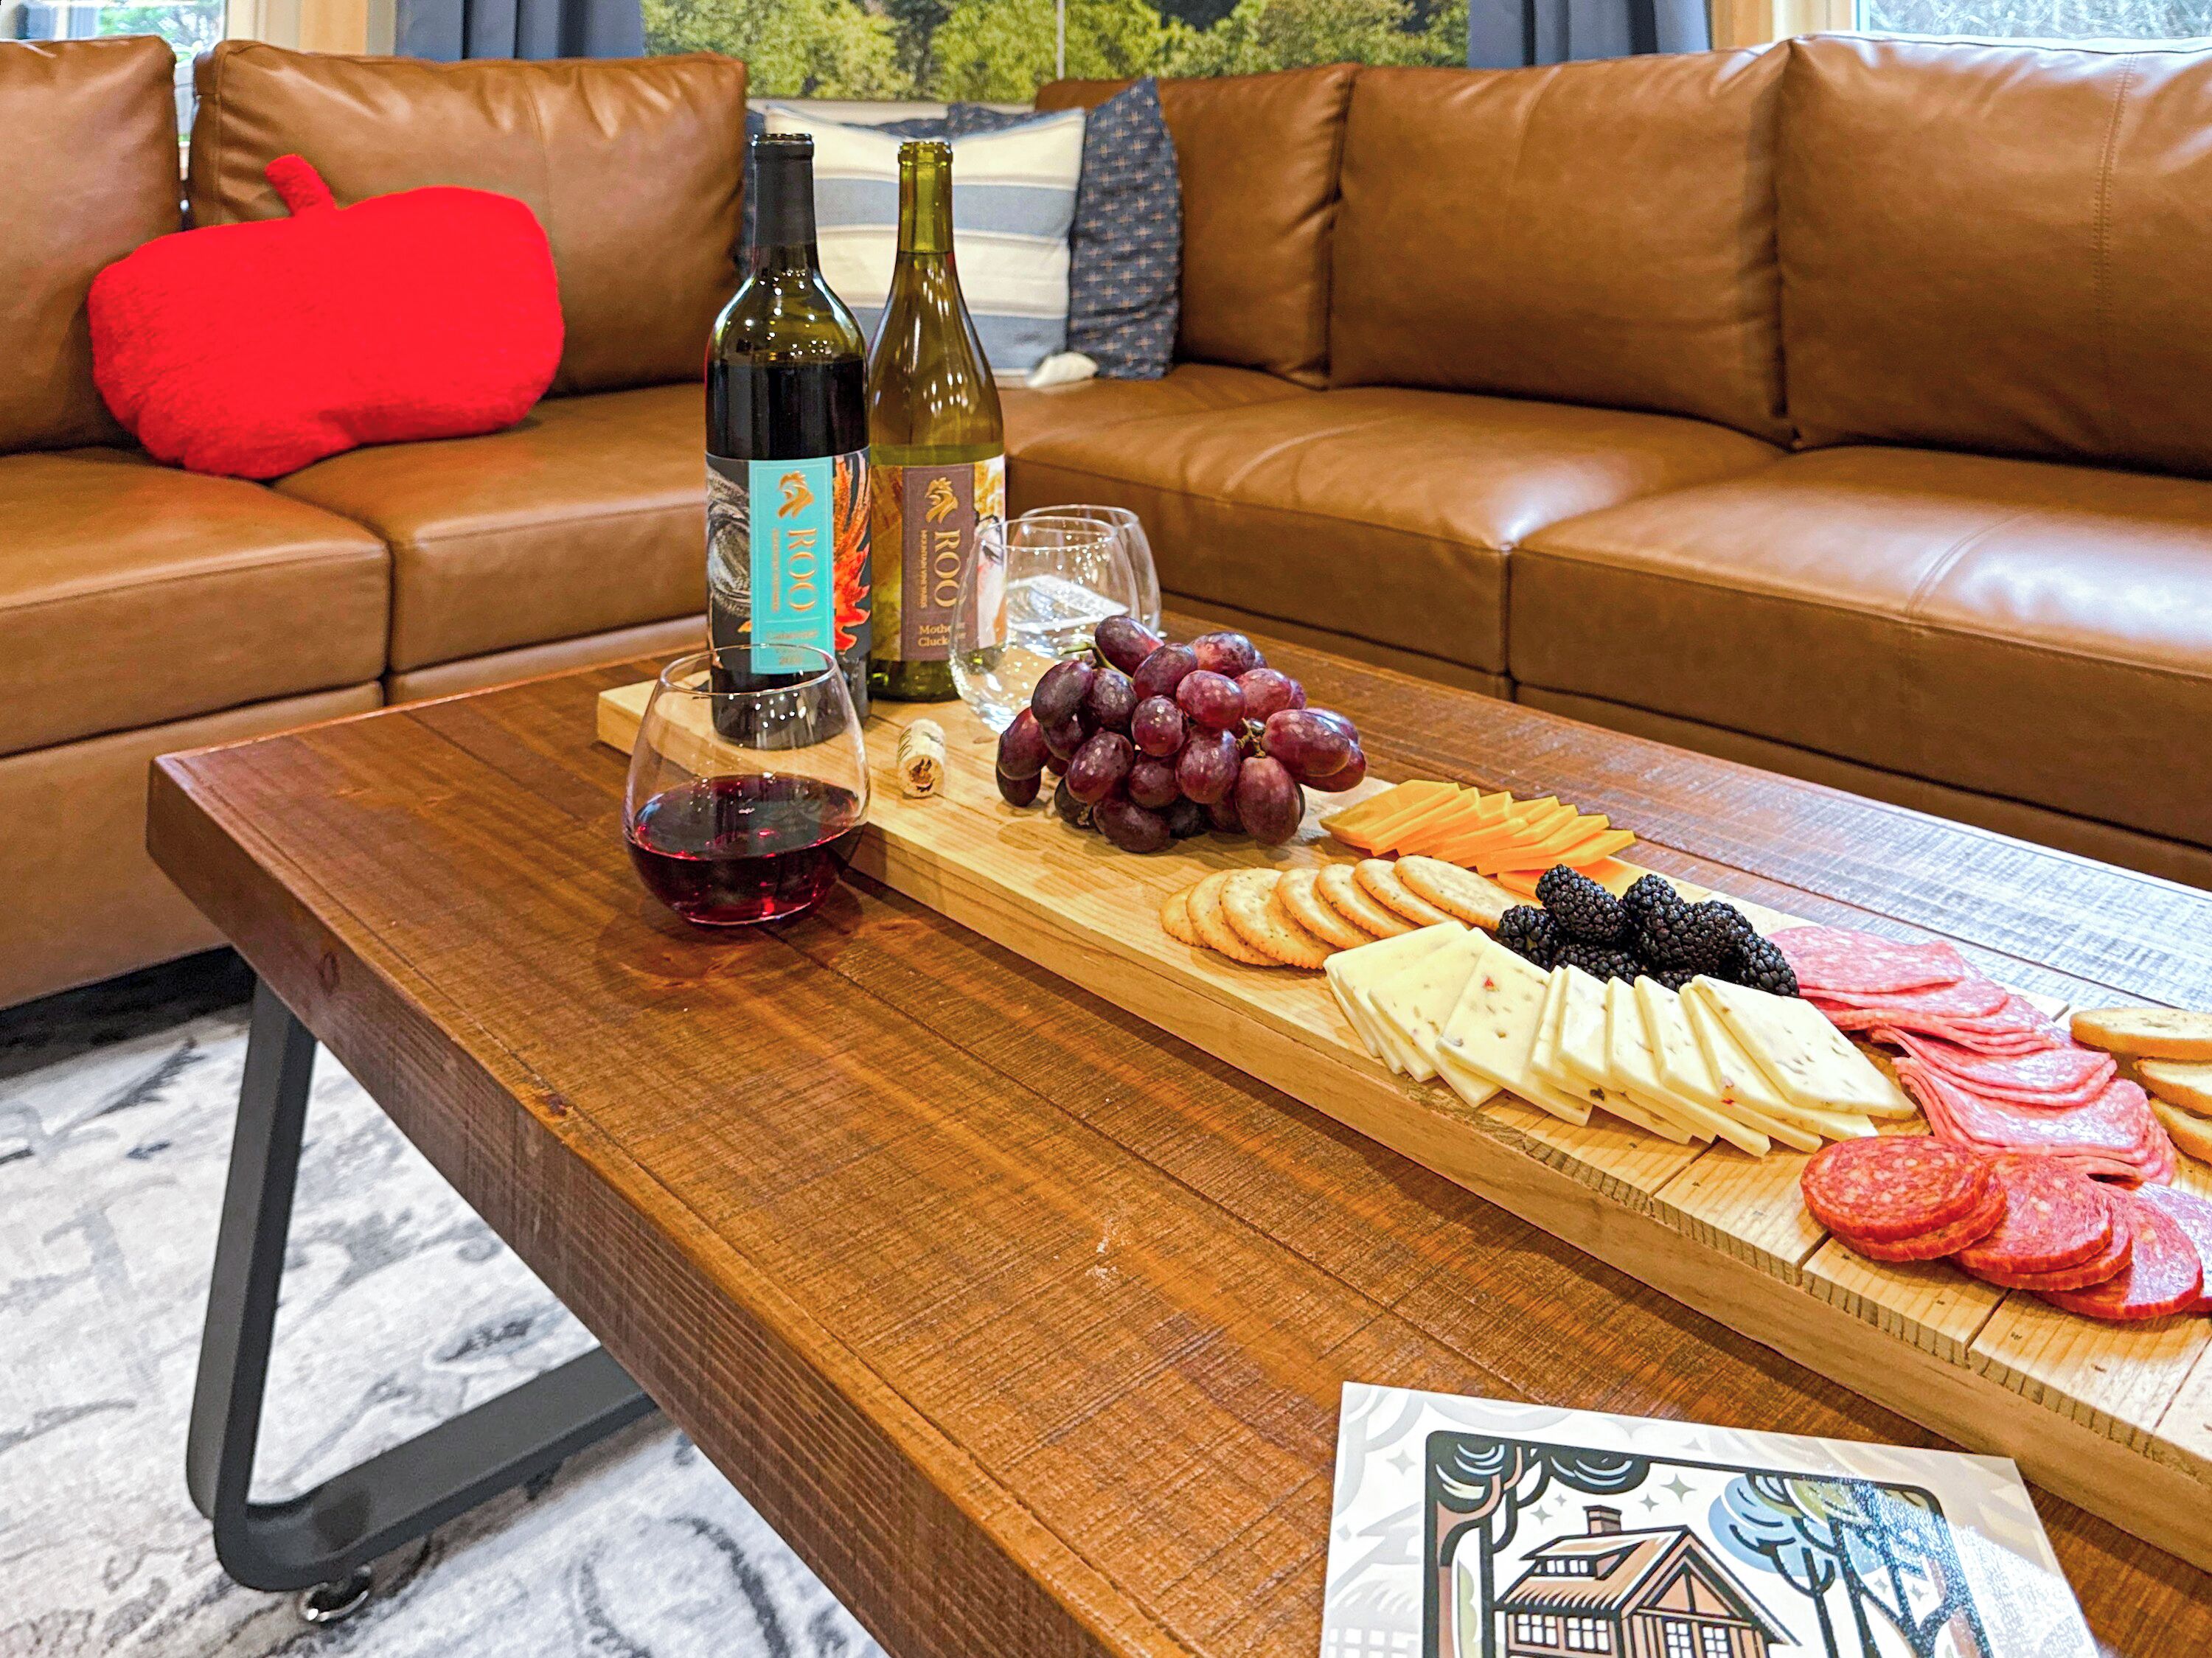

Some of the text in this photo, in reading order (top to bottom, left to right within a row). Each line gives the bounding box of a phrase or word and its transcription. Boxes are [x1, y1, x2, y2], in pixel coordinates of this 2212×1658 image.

[787, 528, 818, 611] ROO
[934, 529, 961, 607] ROO
[917, 633, 964, 647] Cluck
[919, 623, 964, 635] Moth
